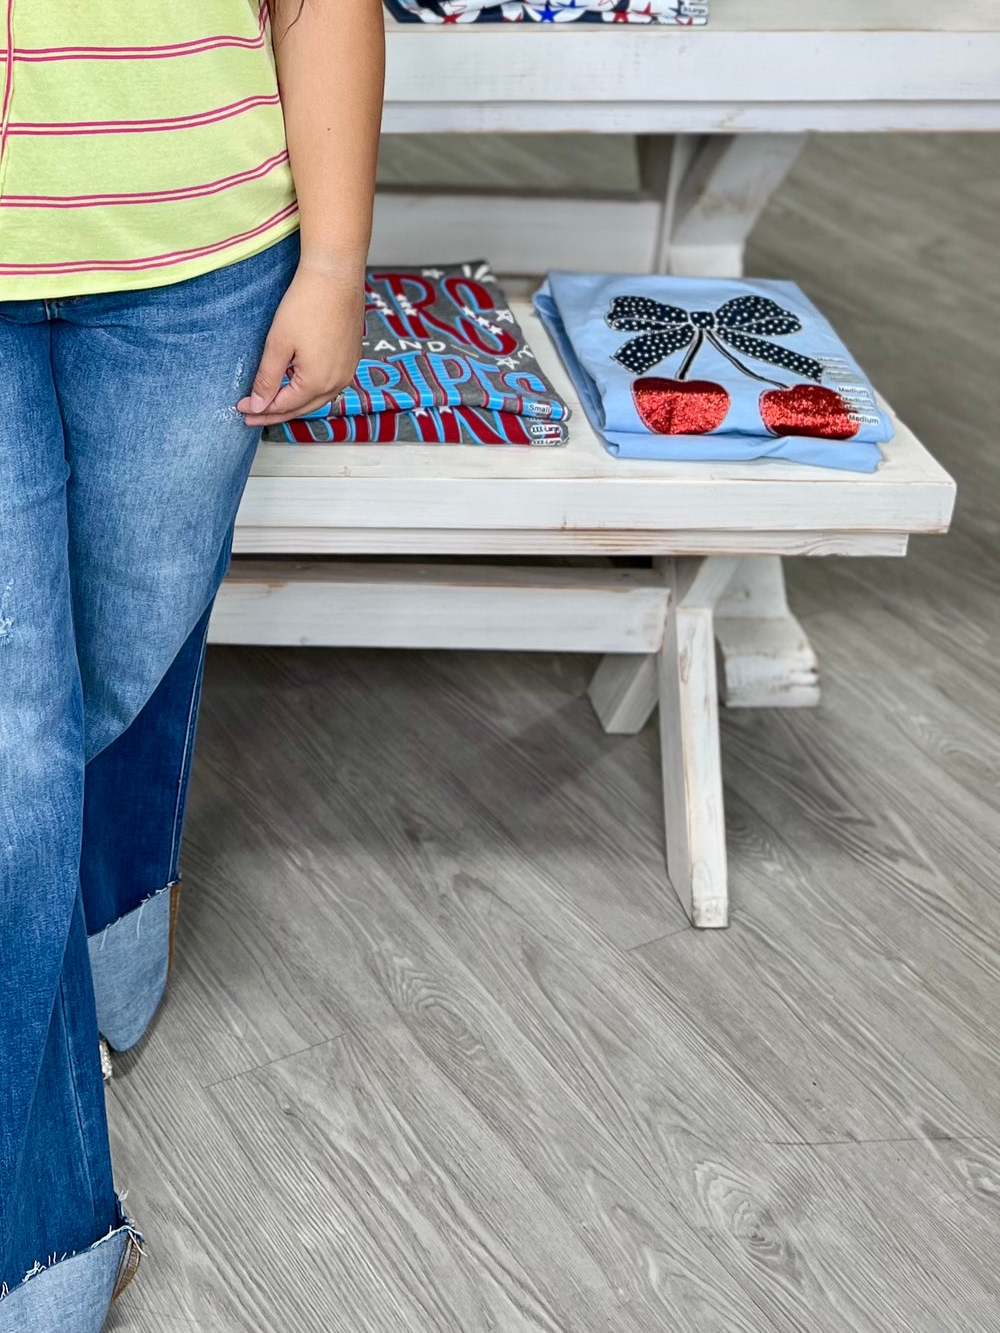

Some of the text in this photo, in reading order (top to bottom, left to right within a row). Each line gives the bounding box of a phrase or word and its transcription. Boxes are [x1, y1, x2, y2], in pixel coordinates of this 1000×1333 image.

[374, 339, 446, 352] AND
[529, 403, 551, 412] Small
[849, 414, 880, 424] Medium
